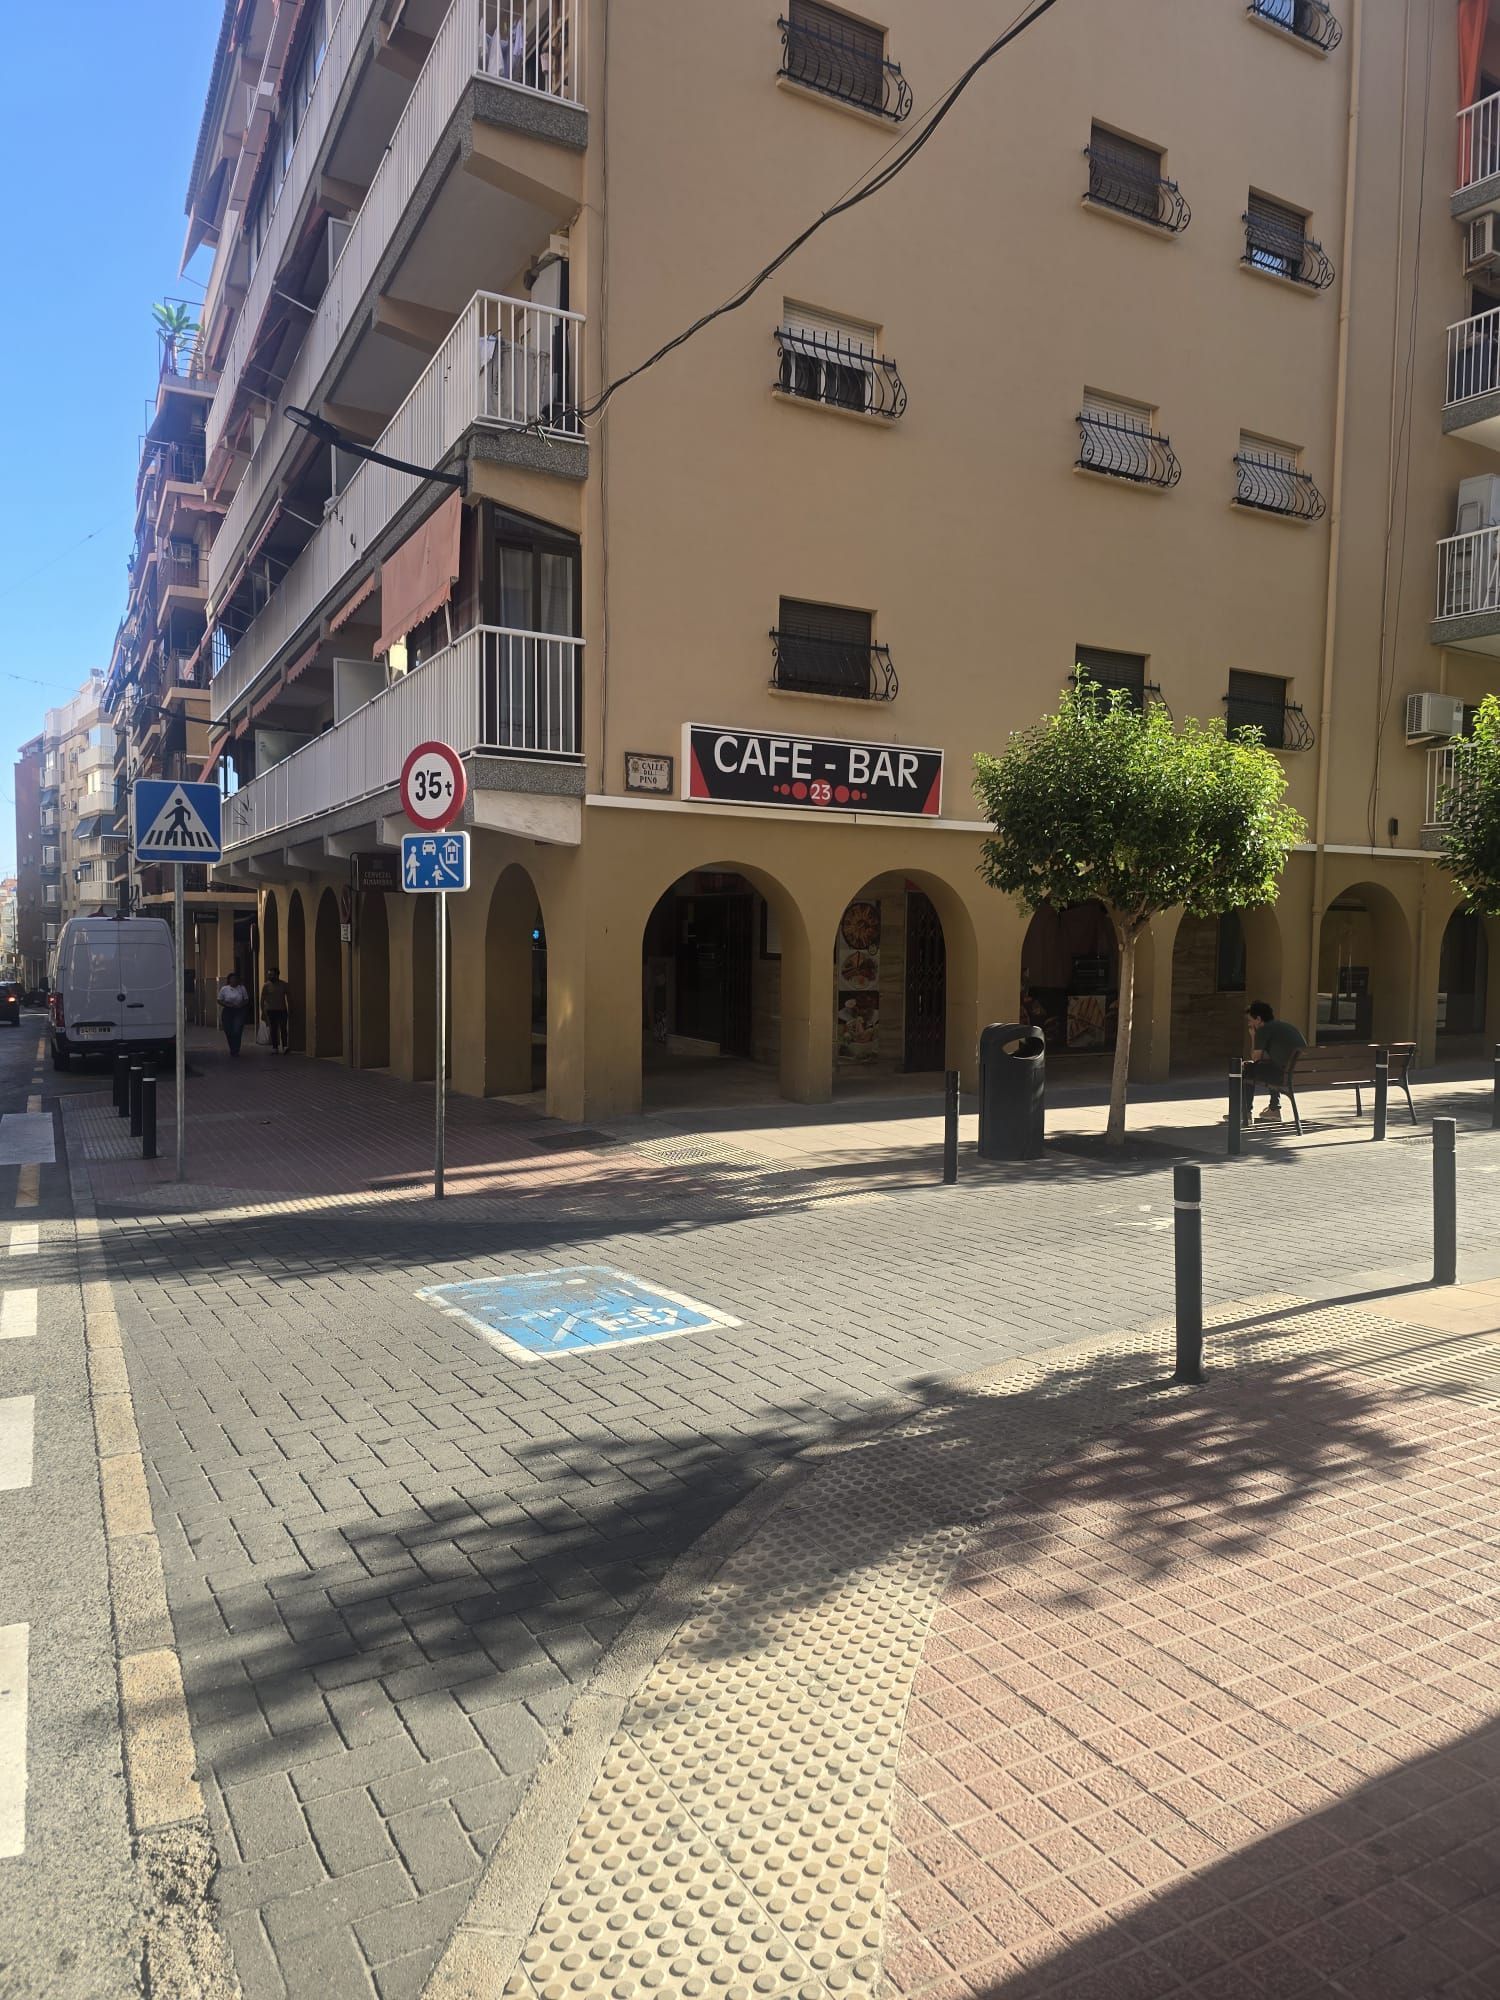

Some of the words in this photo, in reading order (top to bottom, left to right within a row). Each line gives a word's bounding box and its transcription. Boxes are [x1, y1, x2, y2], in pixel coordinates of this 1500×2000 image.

[641, 762, 665, 771] CALLE
[713, 735, 813, 780] CAFE
[848, 748, 919, 789] BAR
[639, 776, 658, 784] PINO
[810, 783, 831, 800] 23
